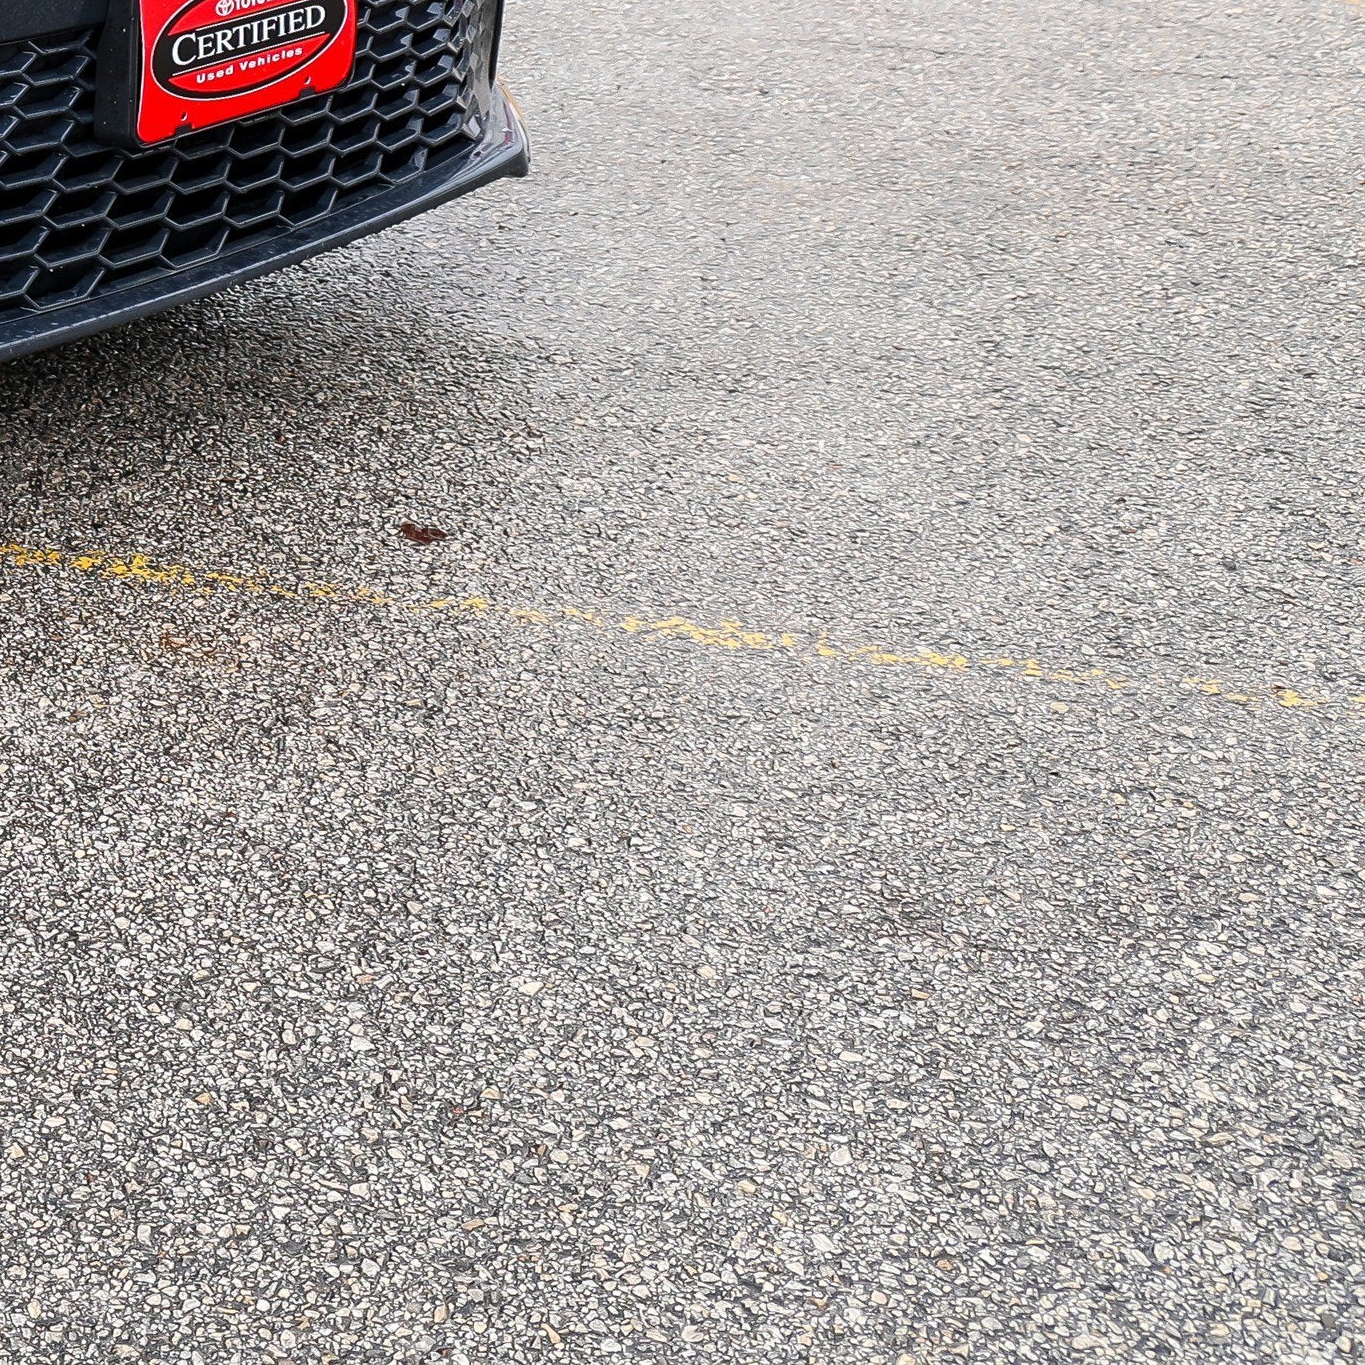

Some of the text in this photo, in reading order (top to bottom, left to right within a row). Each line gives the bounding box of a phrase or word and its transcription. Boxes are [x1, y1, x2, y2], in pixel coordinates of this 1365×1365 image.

[172, 4, 326, 67] CERTIFIED
[195, 46, 304, 85] Used Vehicles
